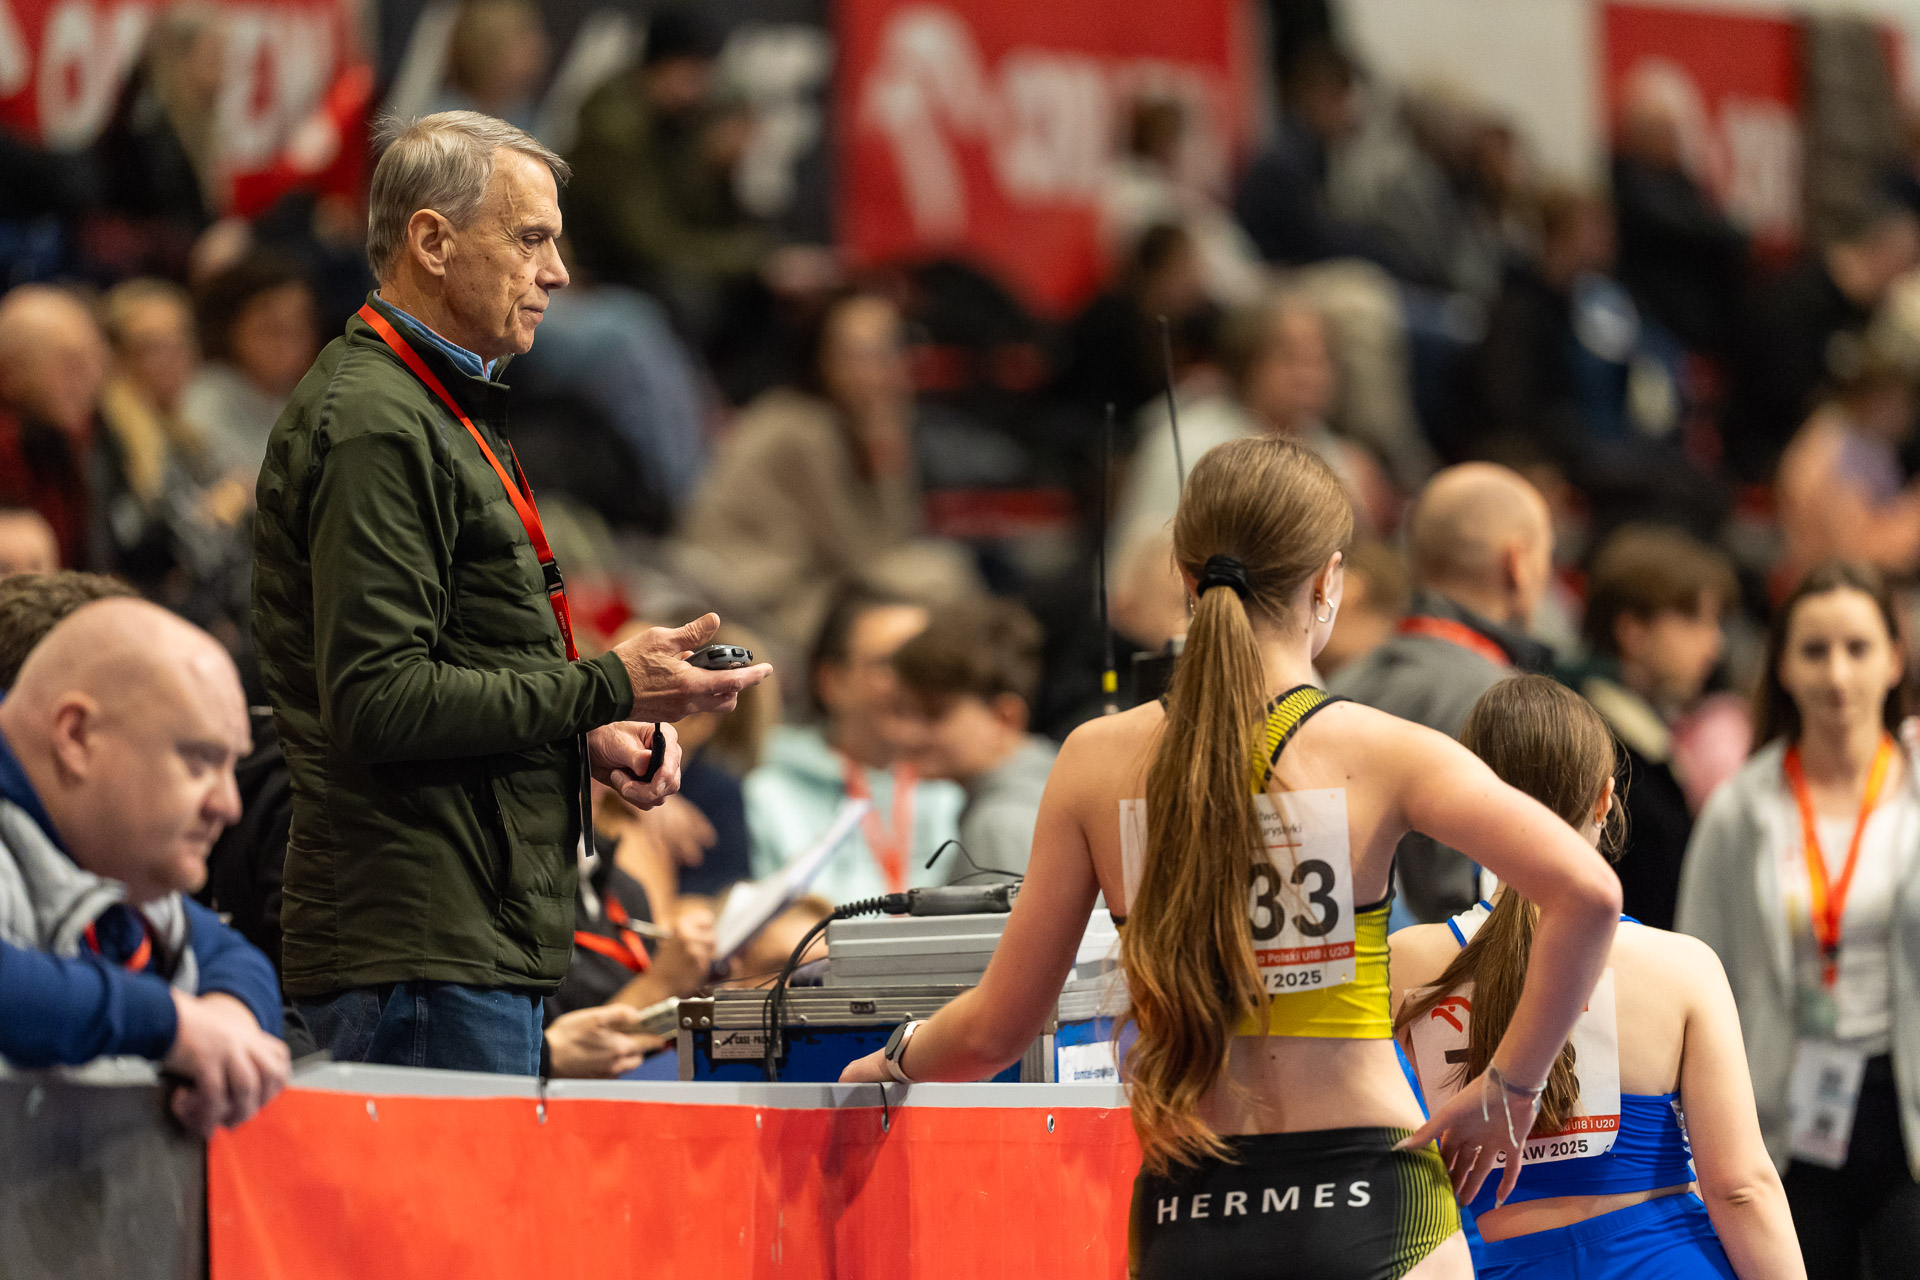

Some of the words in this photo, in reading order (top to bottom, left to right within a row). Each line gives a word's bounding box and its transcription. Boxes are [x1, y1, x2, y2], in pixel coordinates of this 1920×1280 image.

[1302, 949, 1321, 960] U18
[1329, 945, 1351, 957] U20
[1274, 970, 1322, 988] 2025
[1572, 1120, 1588, 1130] U18
[1595, 1118, 1615, 1128] U20
[1550, 1139, 1588, 1157] 2025
[1156, 1180, 1371, 1225] HERMES
